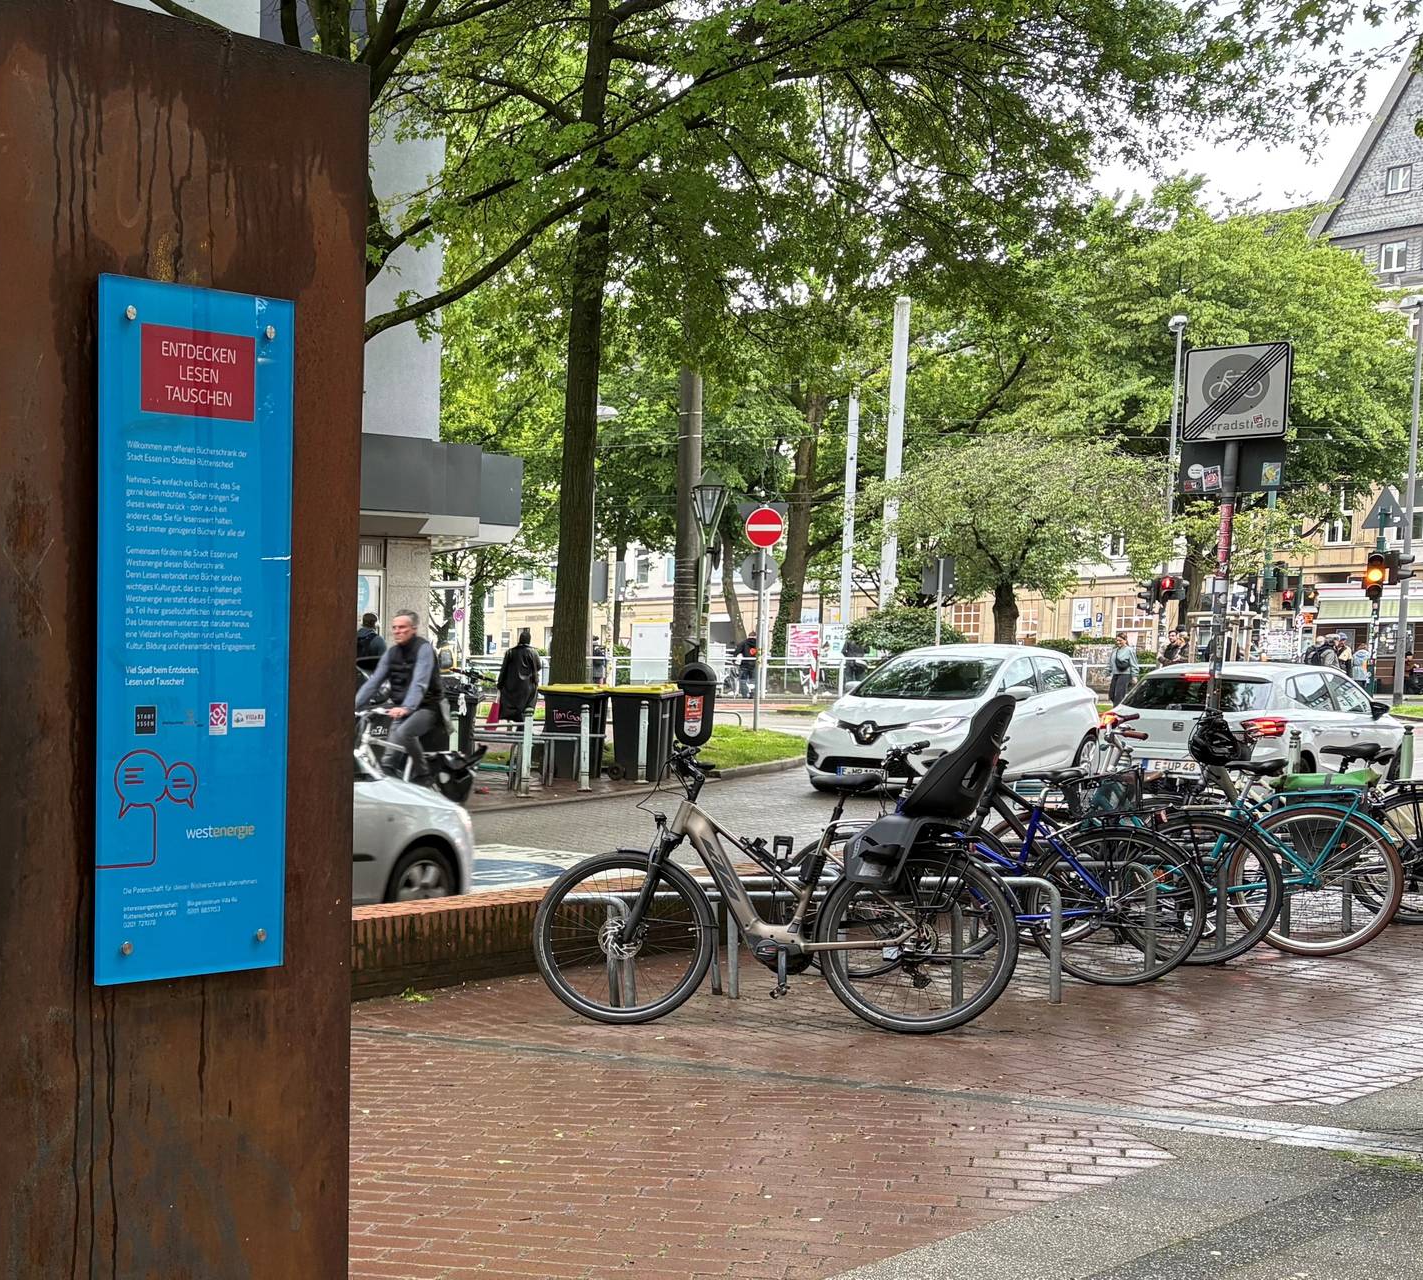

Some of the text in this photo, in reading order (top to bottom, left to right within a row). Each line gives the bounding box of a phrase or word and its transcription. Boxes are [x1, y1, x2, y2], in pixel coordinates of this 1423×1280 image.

[161, 341, 236, 365] ENTDECKEN
[179, 365, 219, 384] LESEN
[165, 385, 232, 407] TAUSCHEN
[127, 452, 196, 465] Stadt Essen im Stadtteil
[185, 823, 255, 840] westenergie
